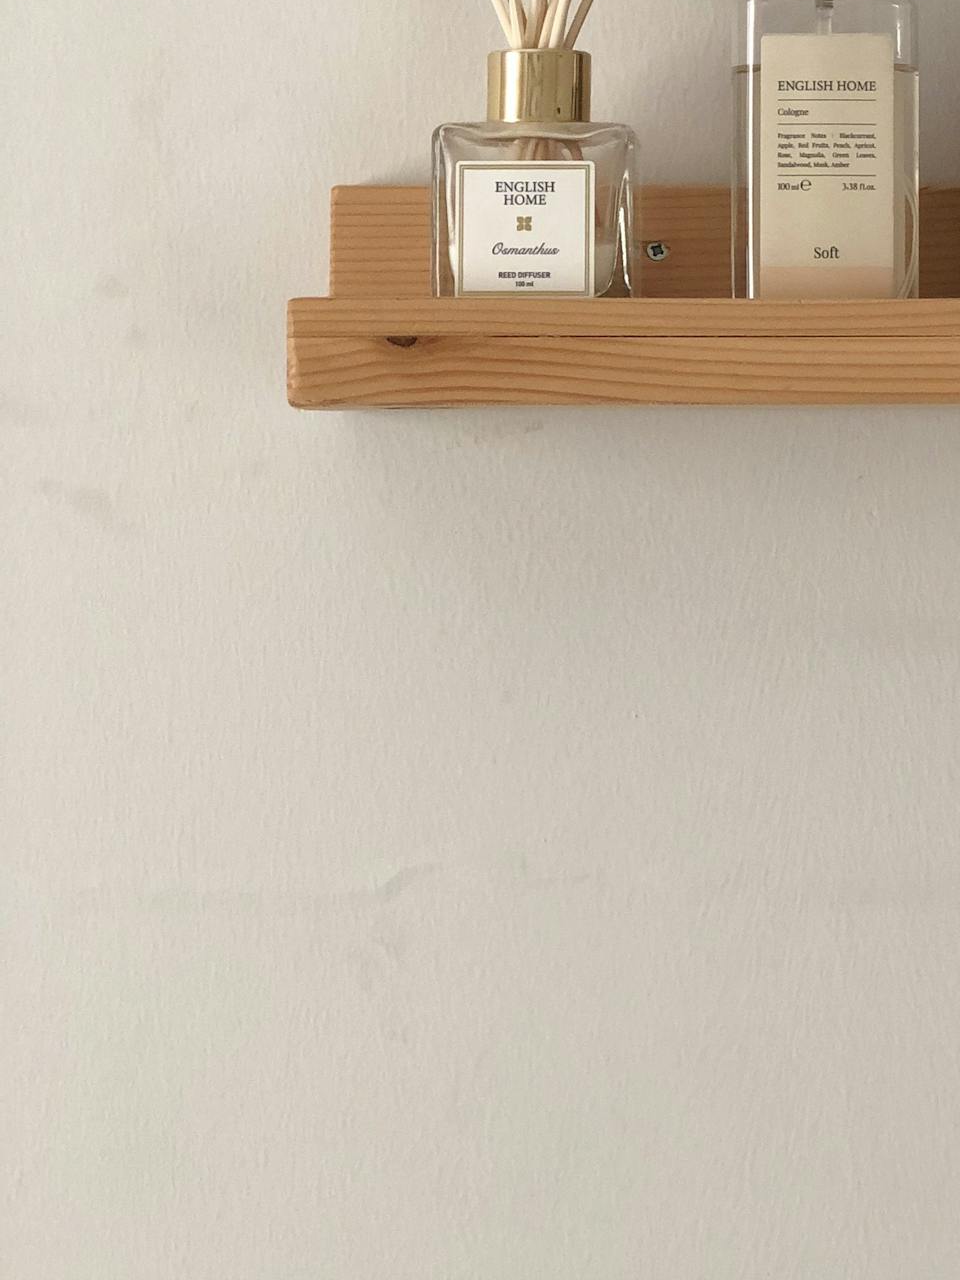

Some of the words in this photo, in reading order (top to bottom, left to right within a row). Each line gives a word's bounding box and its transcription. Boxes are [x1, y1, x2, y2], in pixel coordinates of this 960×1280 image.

[778, 80, 833, 92] ENGLISH
[836, 80, 877, 92] HOME
[777, 107, 809, 118] Cologne
[777, 132, 806, 140] Fragrance
[495, 181, 556, 193] ENGLISH
[777, 183, 791, 191] 100
[842, 183, 858, 191] 3.38
[503, 194, 547, 206] HOME
[492, 241, 560, 256] Osmanthus
[813, 246, 840, 260] Soft
[498, 271, 517, 279] REED
[517, 271, 551, 279] DIFFUSER
